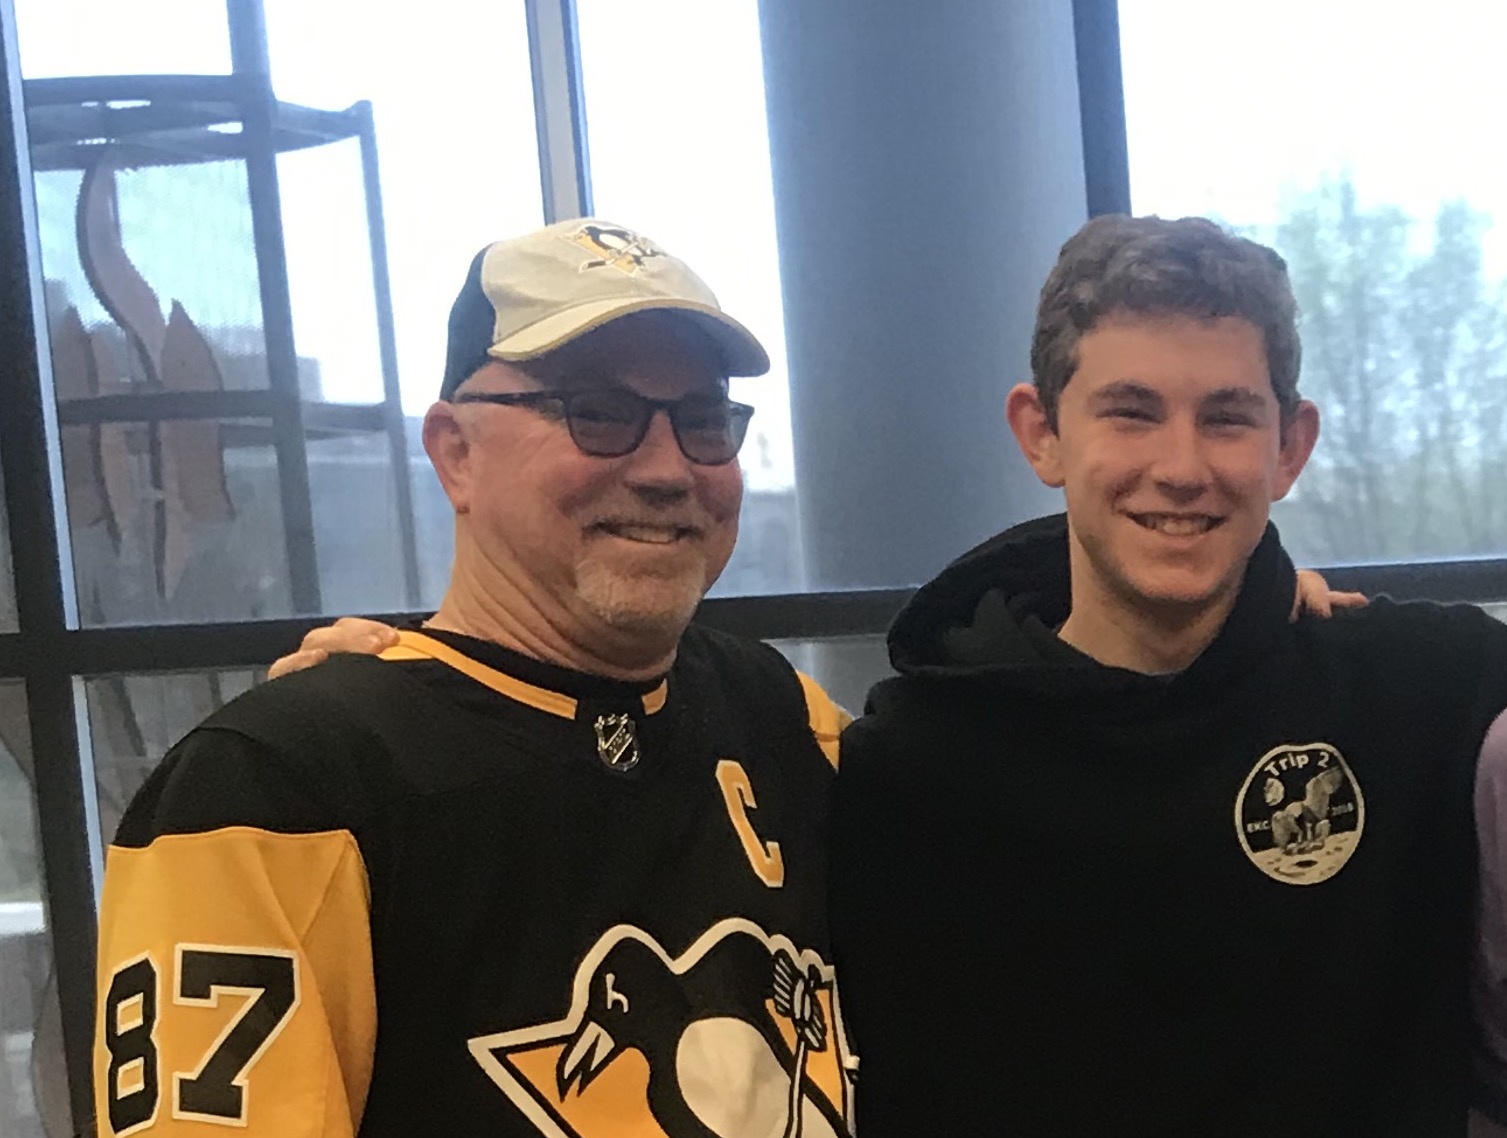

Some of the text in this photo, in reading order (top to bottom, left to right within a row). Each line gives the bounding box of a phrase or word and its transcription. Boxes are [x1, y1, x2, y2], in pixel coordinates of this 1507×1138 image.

[1264, 751, 1330, 776] Trip 2
[715, 759, 784, 888] C
